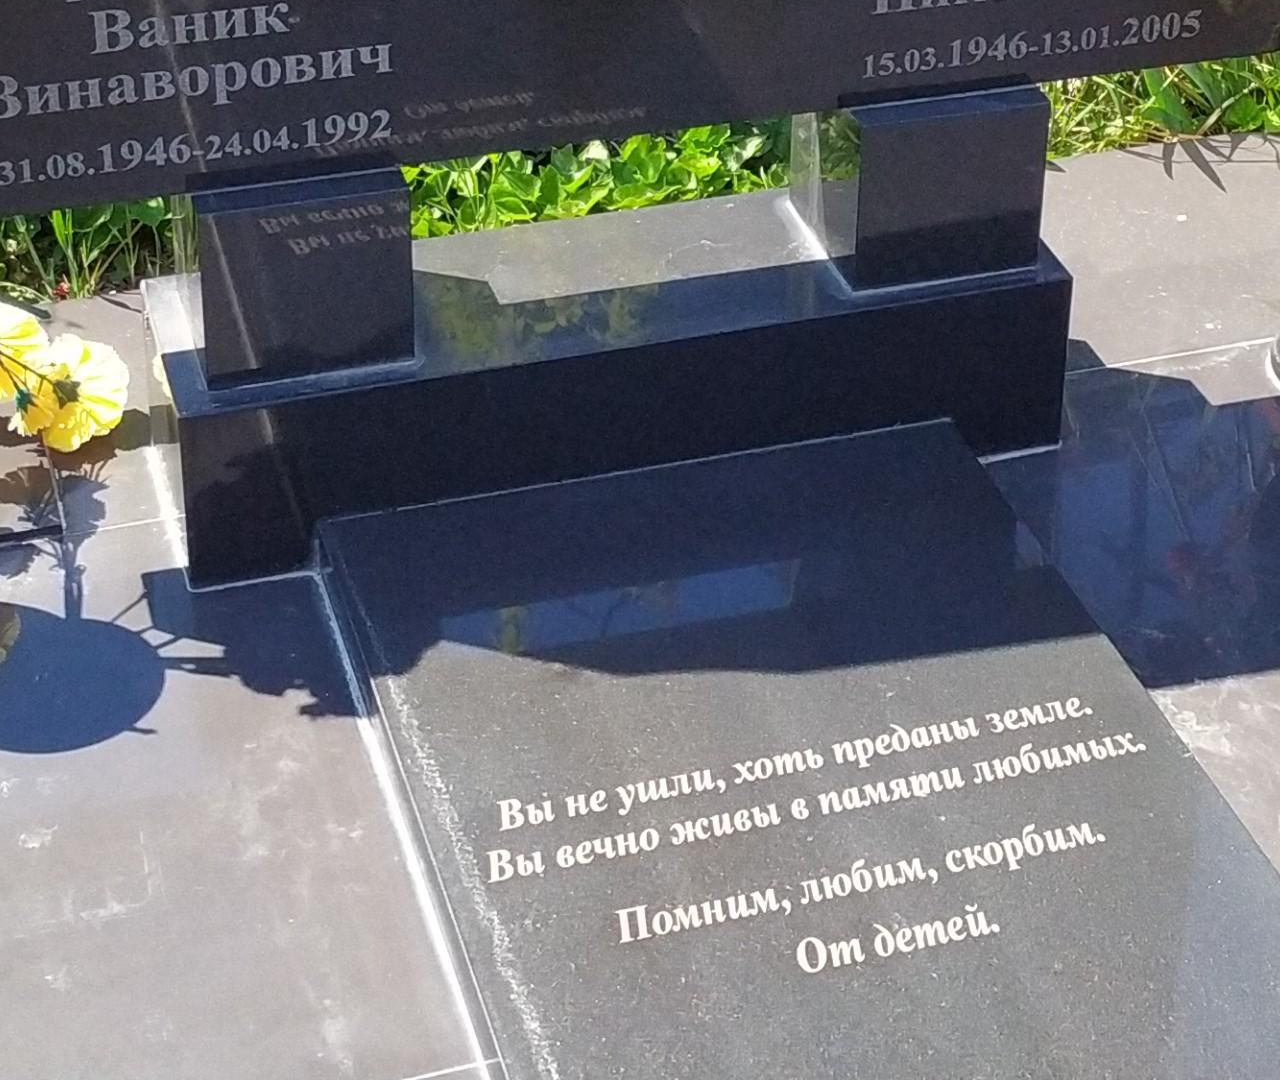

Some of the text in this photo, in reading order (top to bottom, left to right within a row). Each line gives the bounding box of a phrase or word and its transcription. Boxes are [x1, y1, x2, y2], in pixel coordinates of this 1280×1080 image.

[89, 1, 291, 55] Ваник
[862, 9, 1203, 78] 15.03.1946-13.01.2005
[486, 731, 1147, 884] Вы вечно живы в памяти любимых.
[496, 695, 1094, 832] Вы не ушли, хоть преданы земле.
[615, 822, 1107, 943] Помним, любим, скорбим.
[796, 904, 1001, 974] От детей.
